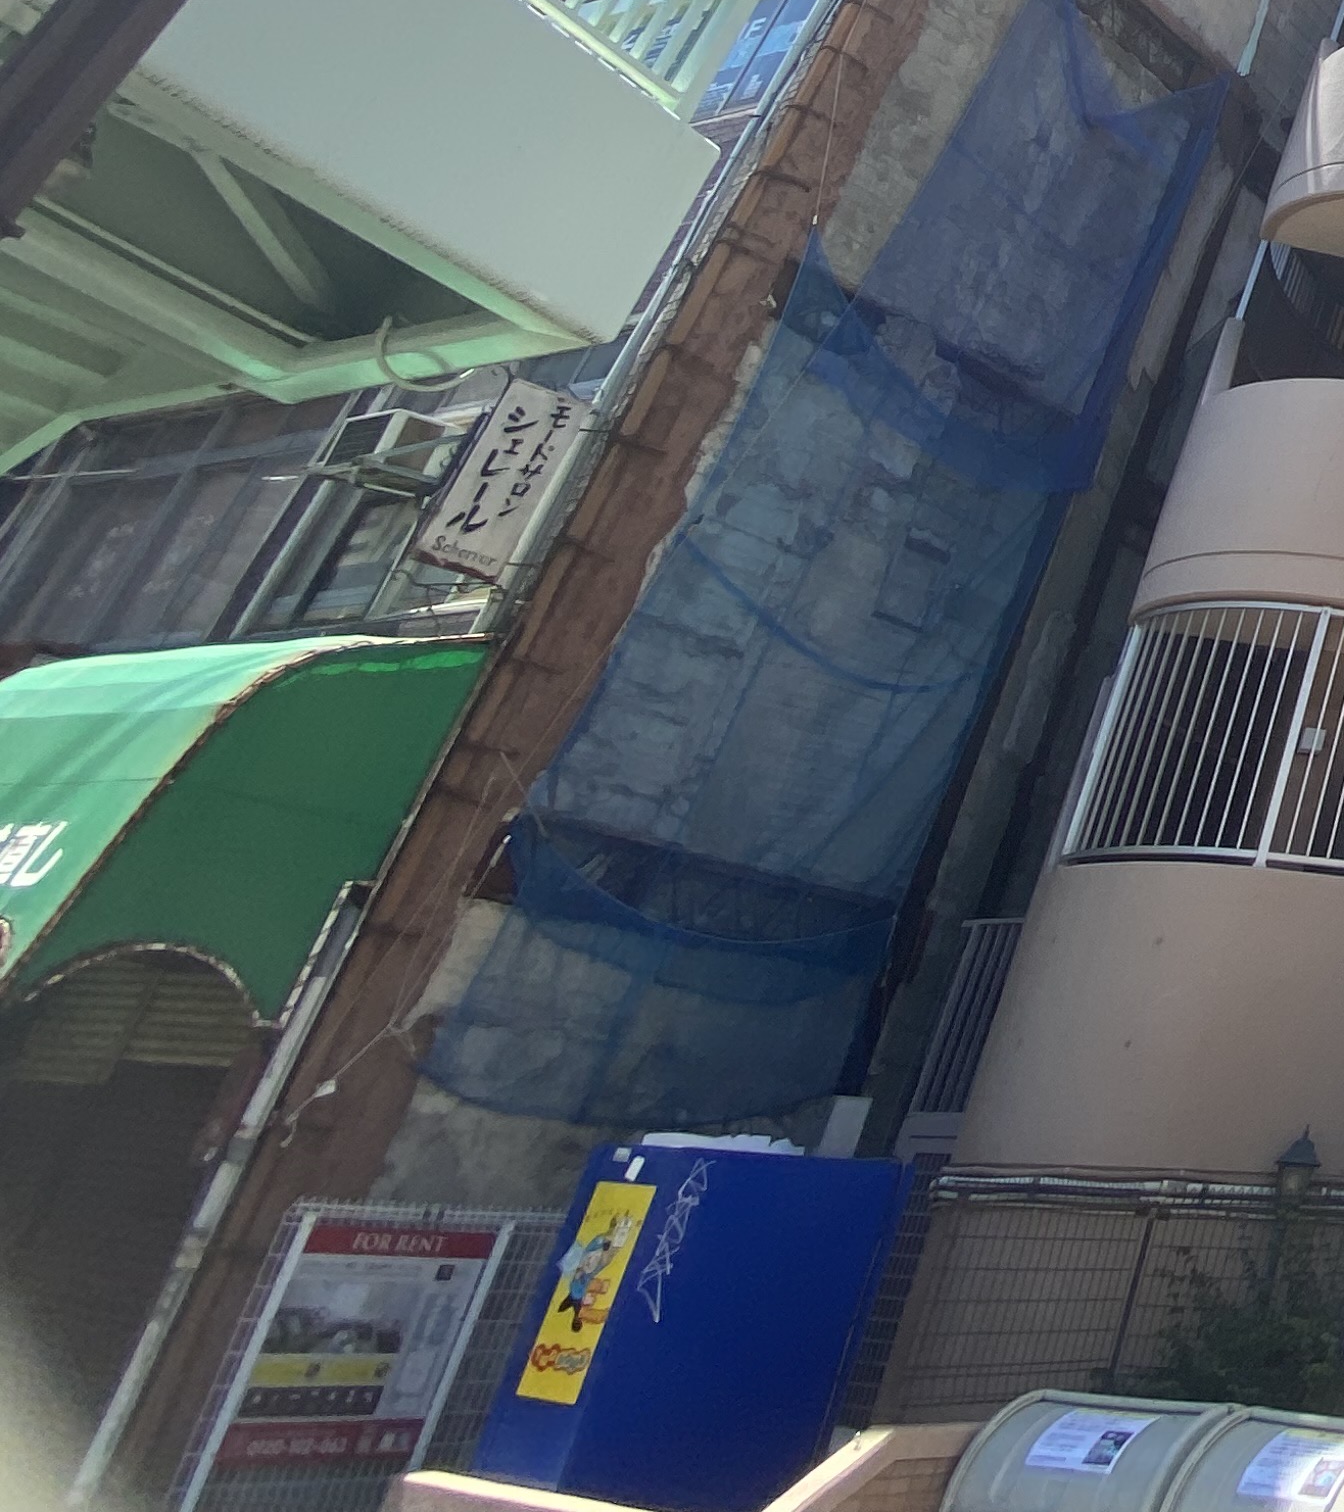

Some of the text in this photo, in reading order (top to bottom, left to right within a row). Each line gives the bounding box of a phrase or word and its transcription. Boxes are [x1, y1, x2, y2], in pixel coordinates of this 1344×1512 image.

[446, 406, 540, 534] シェレール
[498, 404, 572, 517] モードサロン
[0, 821, 68, 886] 直し
[352, 1231, 448, 1253] FOR RENT
